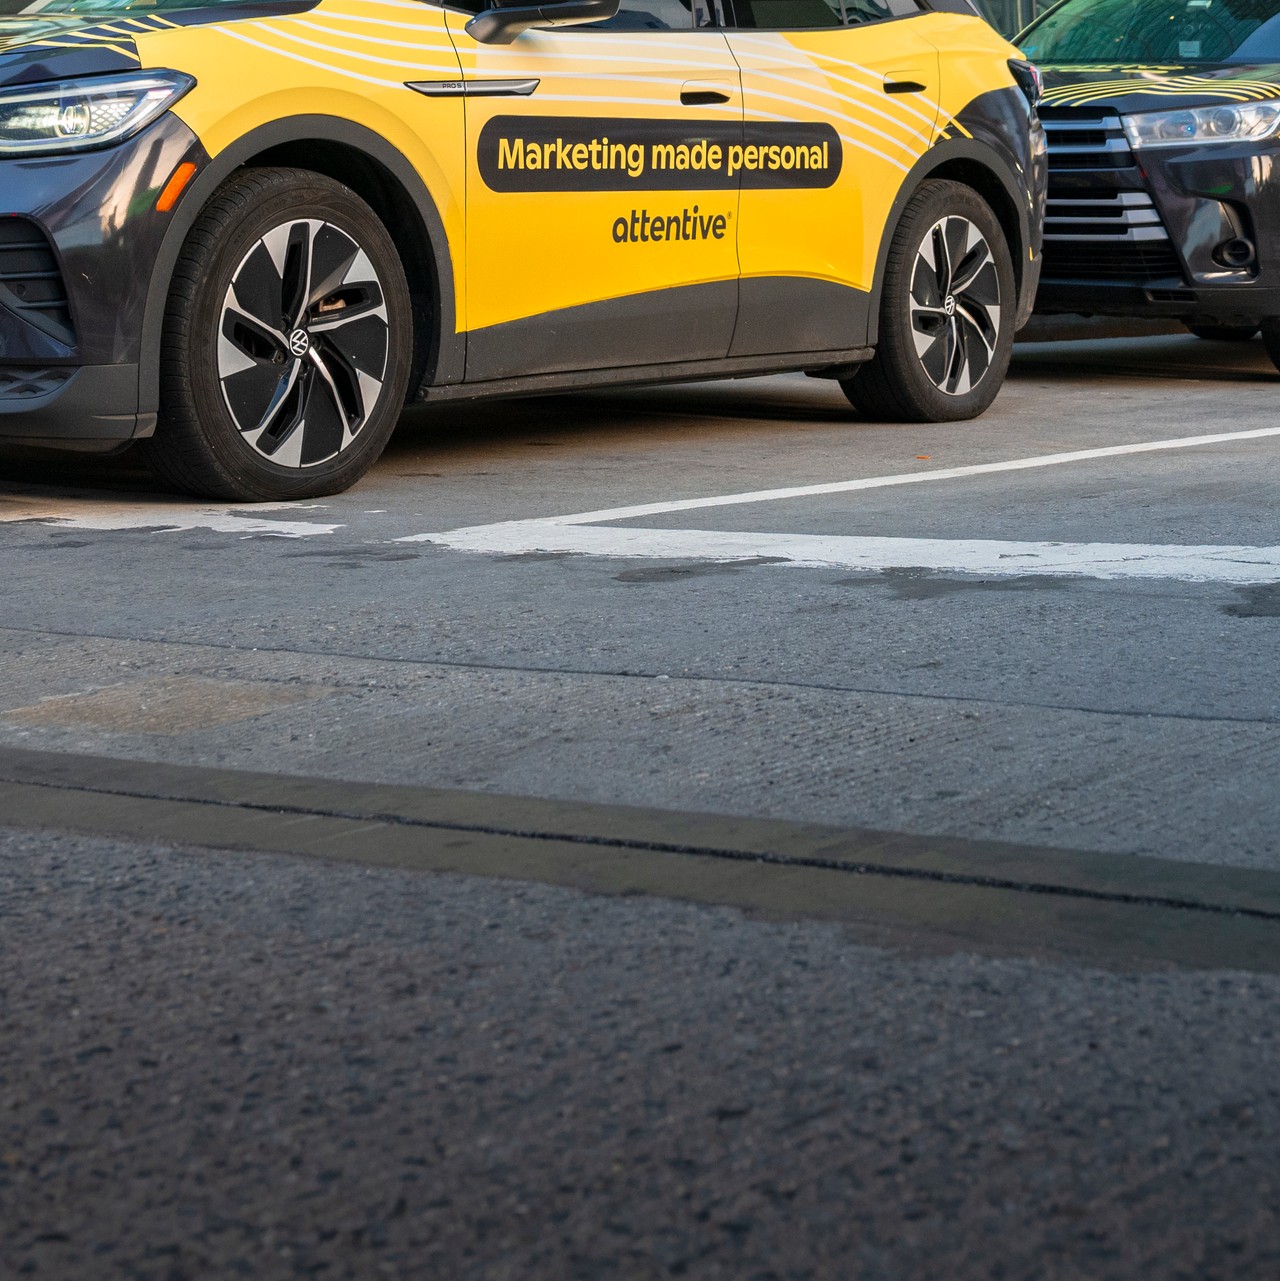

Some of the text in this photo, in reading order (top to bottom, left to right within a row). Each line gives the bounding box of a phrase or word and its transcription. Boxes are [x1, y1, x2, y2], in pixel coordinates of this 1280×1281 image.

[497, 137, 829, 178] Marketing made personal
